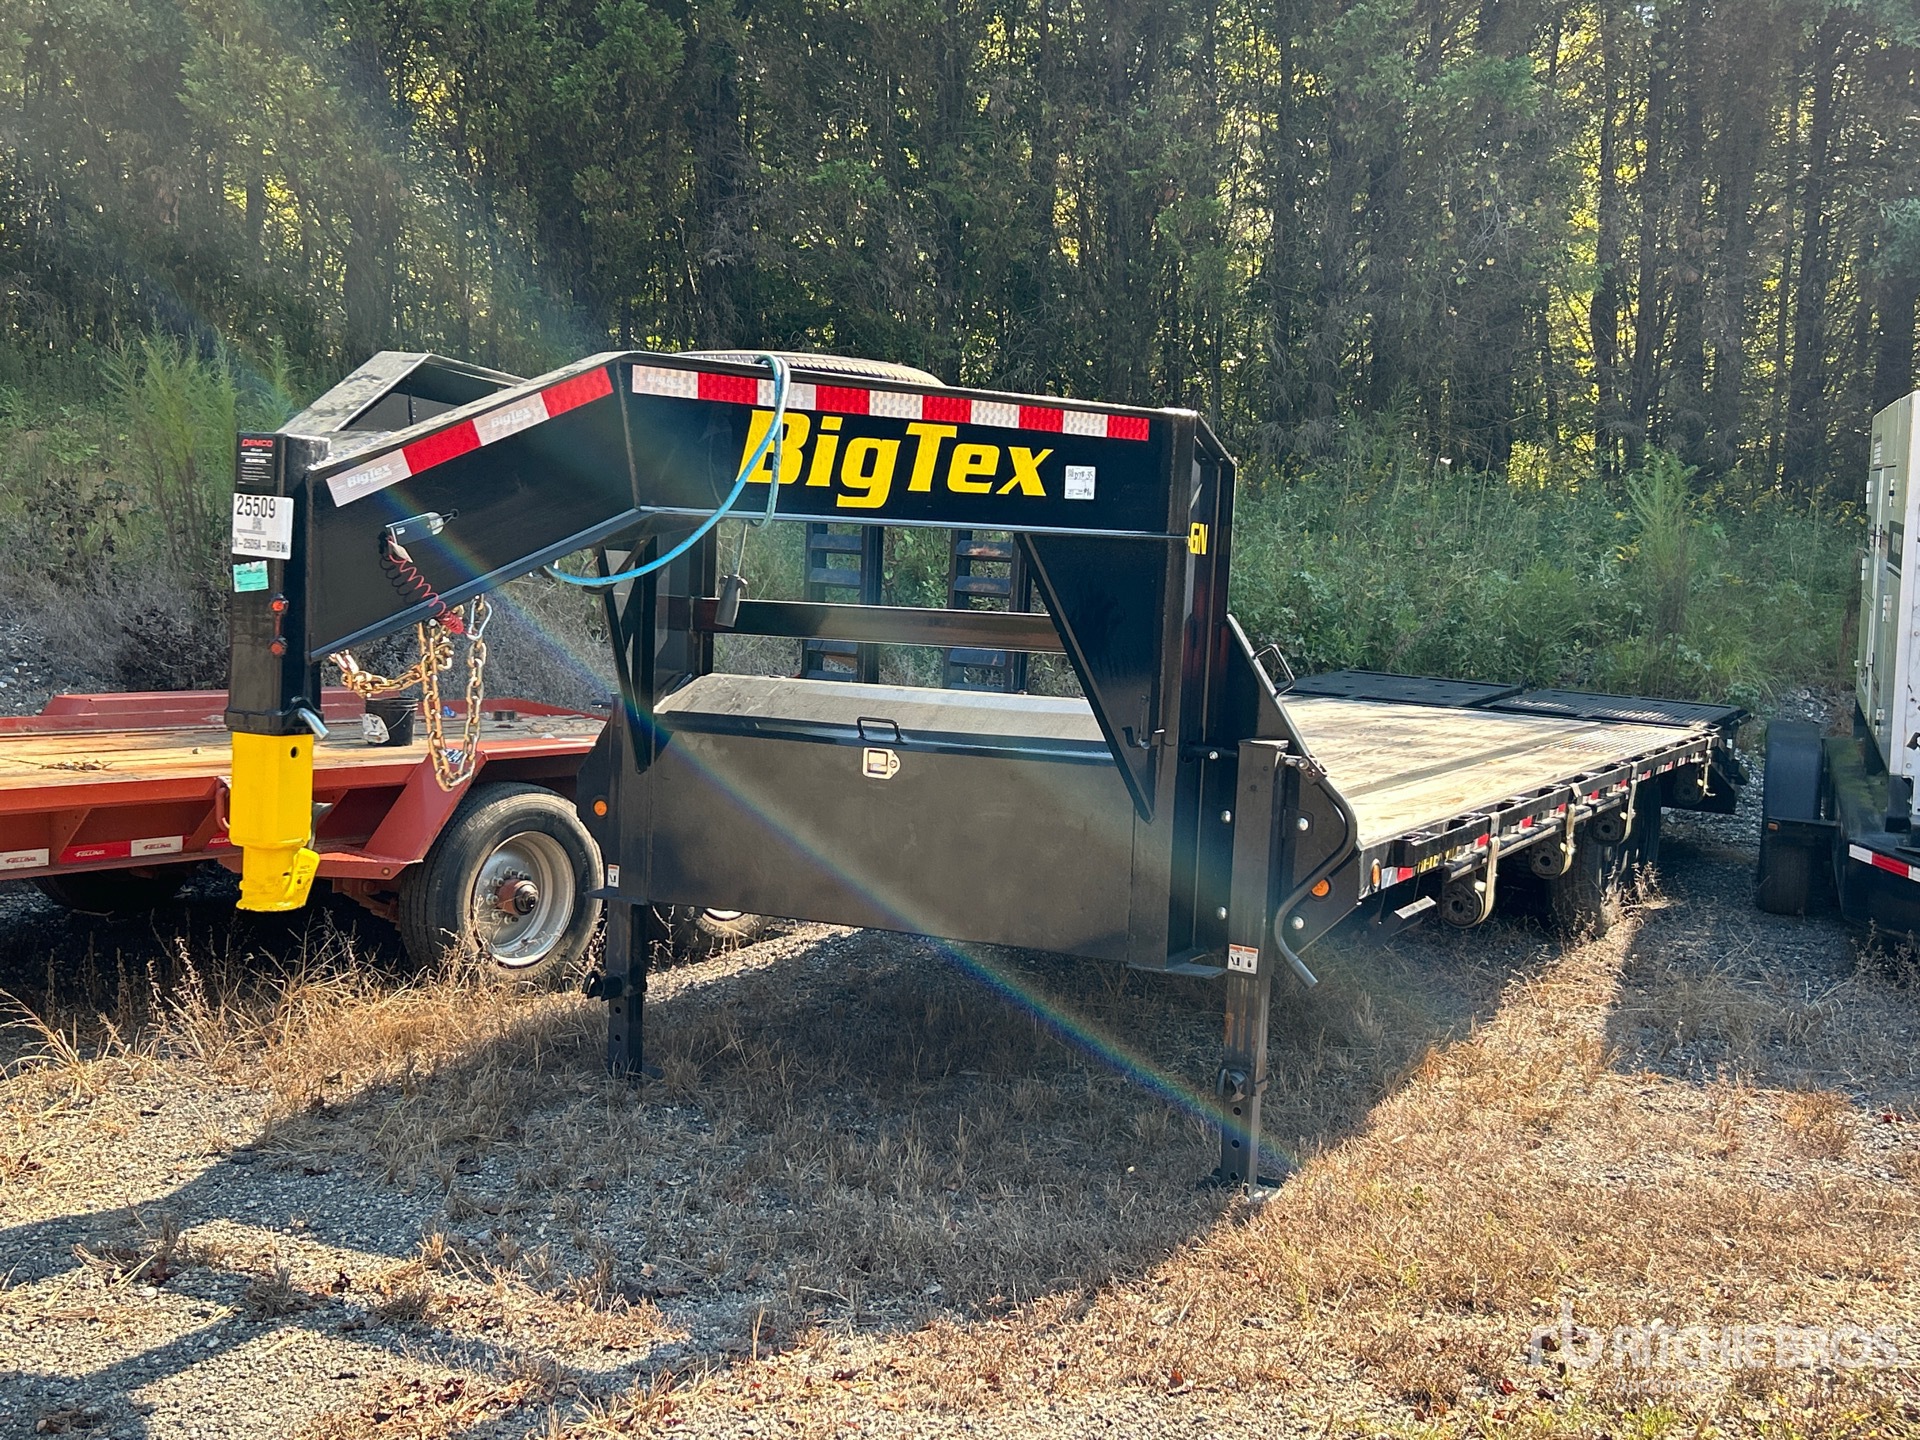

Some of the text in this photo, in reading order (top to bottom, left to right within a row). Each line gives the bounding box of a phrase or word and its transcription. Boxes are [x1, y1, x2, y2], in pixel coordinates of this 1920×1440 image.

[241, 439, 273, 447] DEMCO
[735, 409, 1055, 508] BigTex
[346, 464, 390, 487] BigTex
[236, 495, 276, 518] 25509
